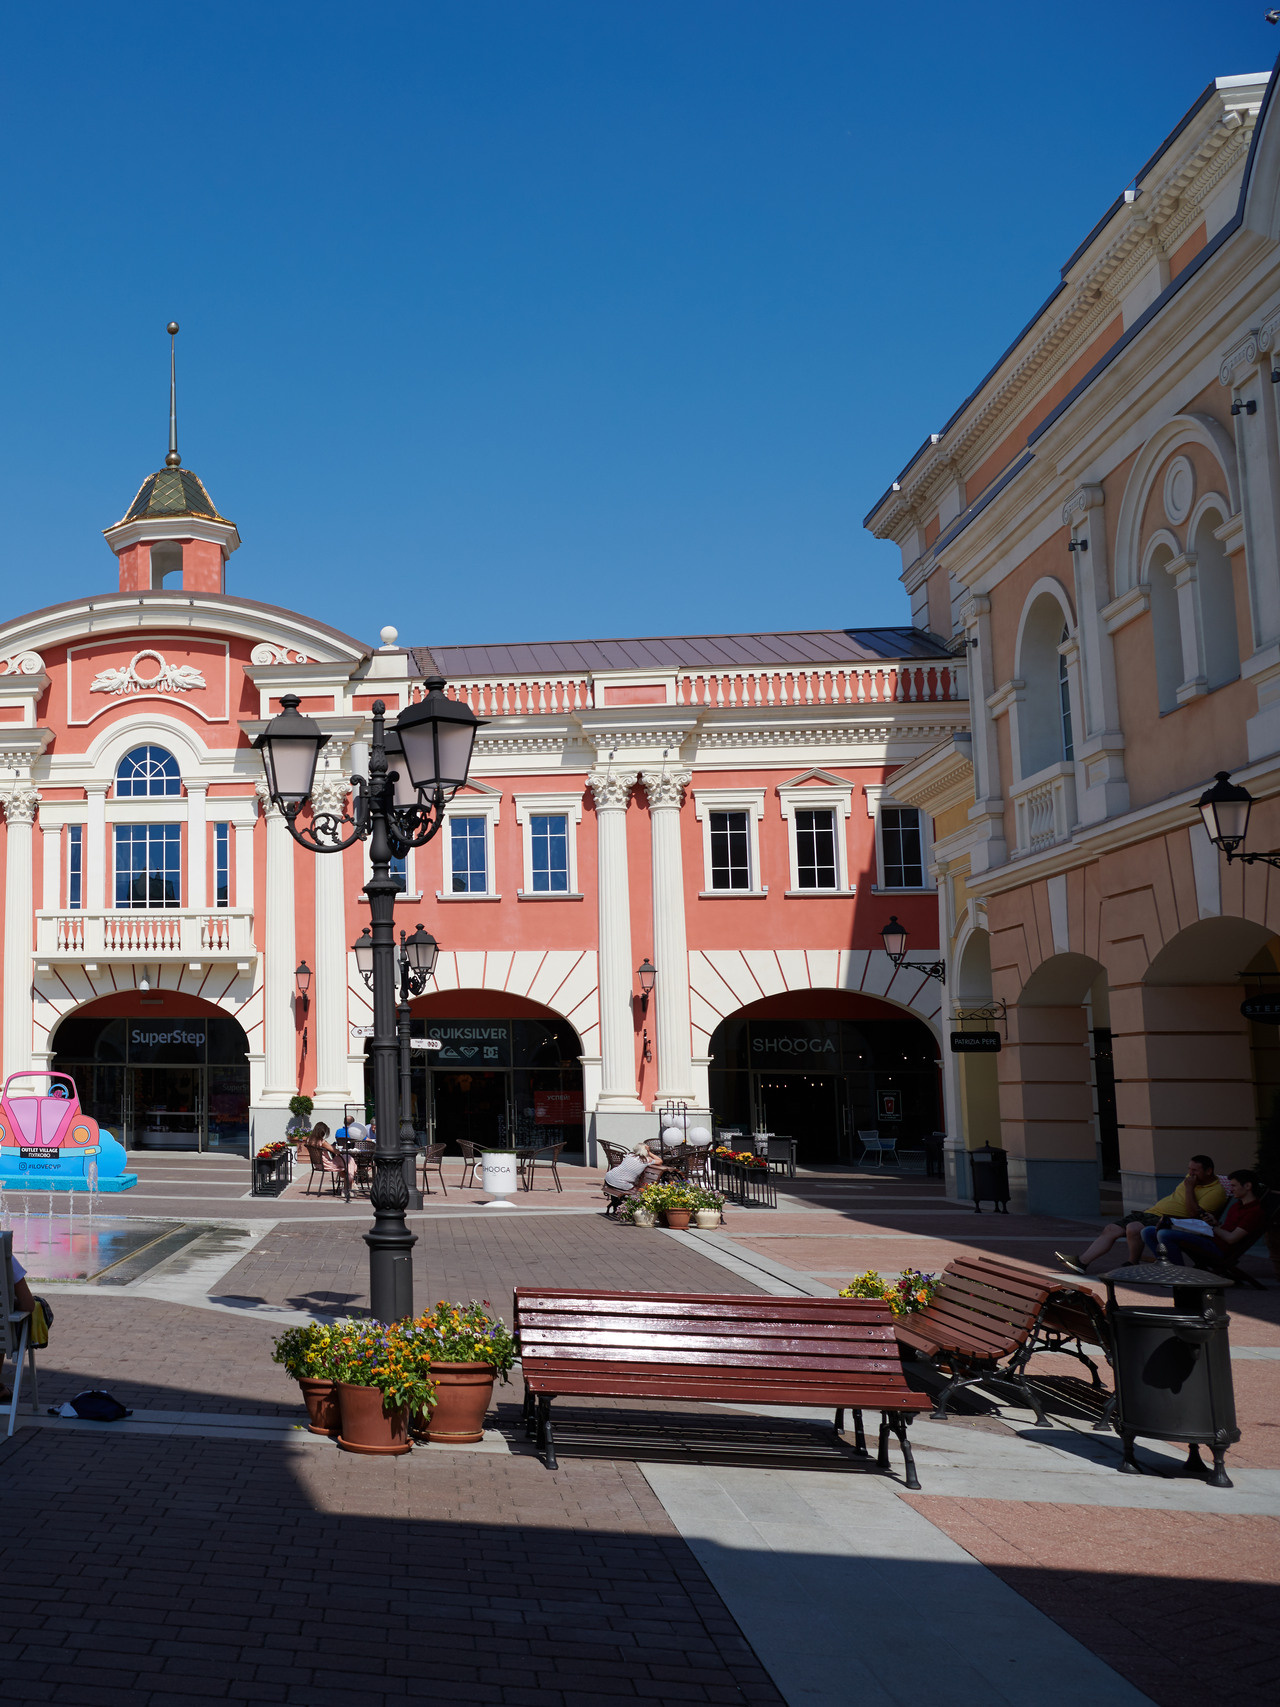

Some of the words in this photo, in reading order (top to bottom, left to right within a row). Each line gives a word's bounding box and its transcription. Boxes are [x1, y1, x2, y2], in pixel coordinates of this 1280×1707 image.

[131, 1029, 206, 1047] SuperStep
[429, 1027, 508, 1040] QUIKSILVER
[752, 1036, 836, 1056] SHOOGA
